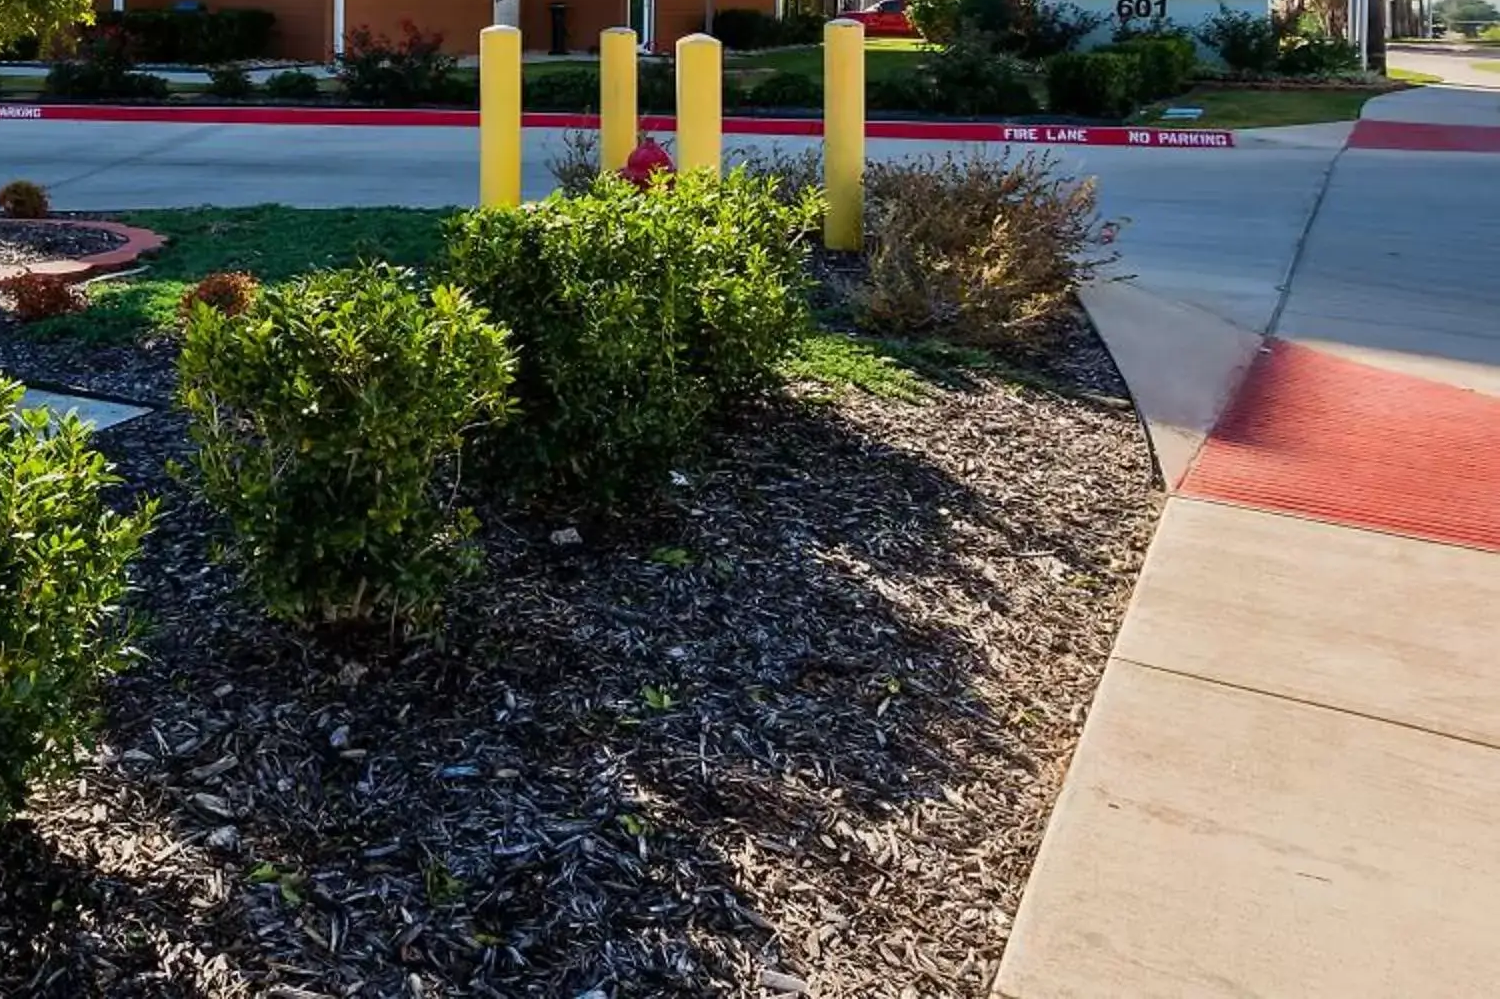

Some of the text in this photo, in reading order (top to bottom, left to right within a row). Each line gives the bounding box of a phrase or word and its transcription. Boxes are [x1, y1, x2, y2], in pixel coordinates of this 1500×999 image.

[1004, 128, 1088, 141] FIRE LANE
[1128, 131, 1228, 146] NO PARKING
